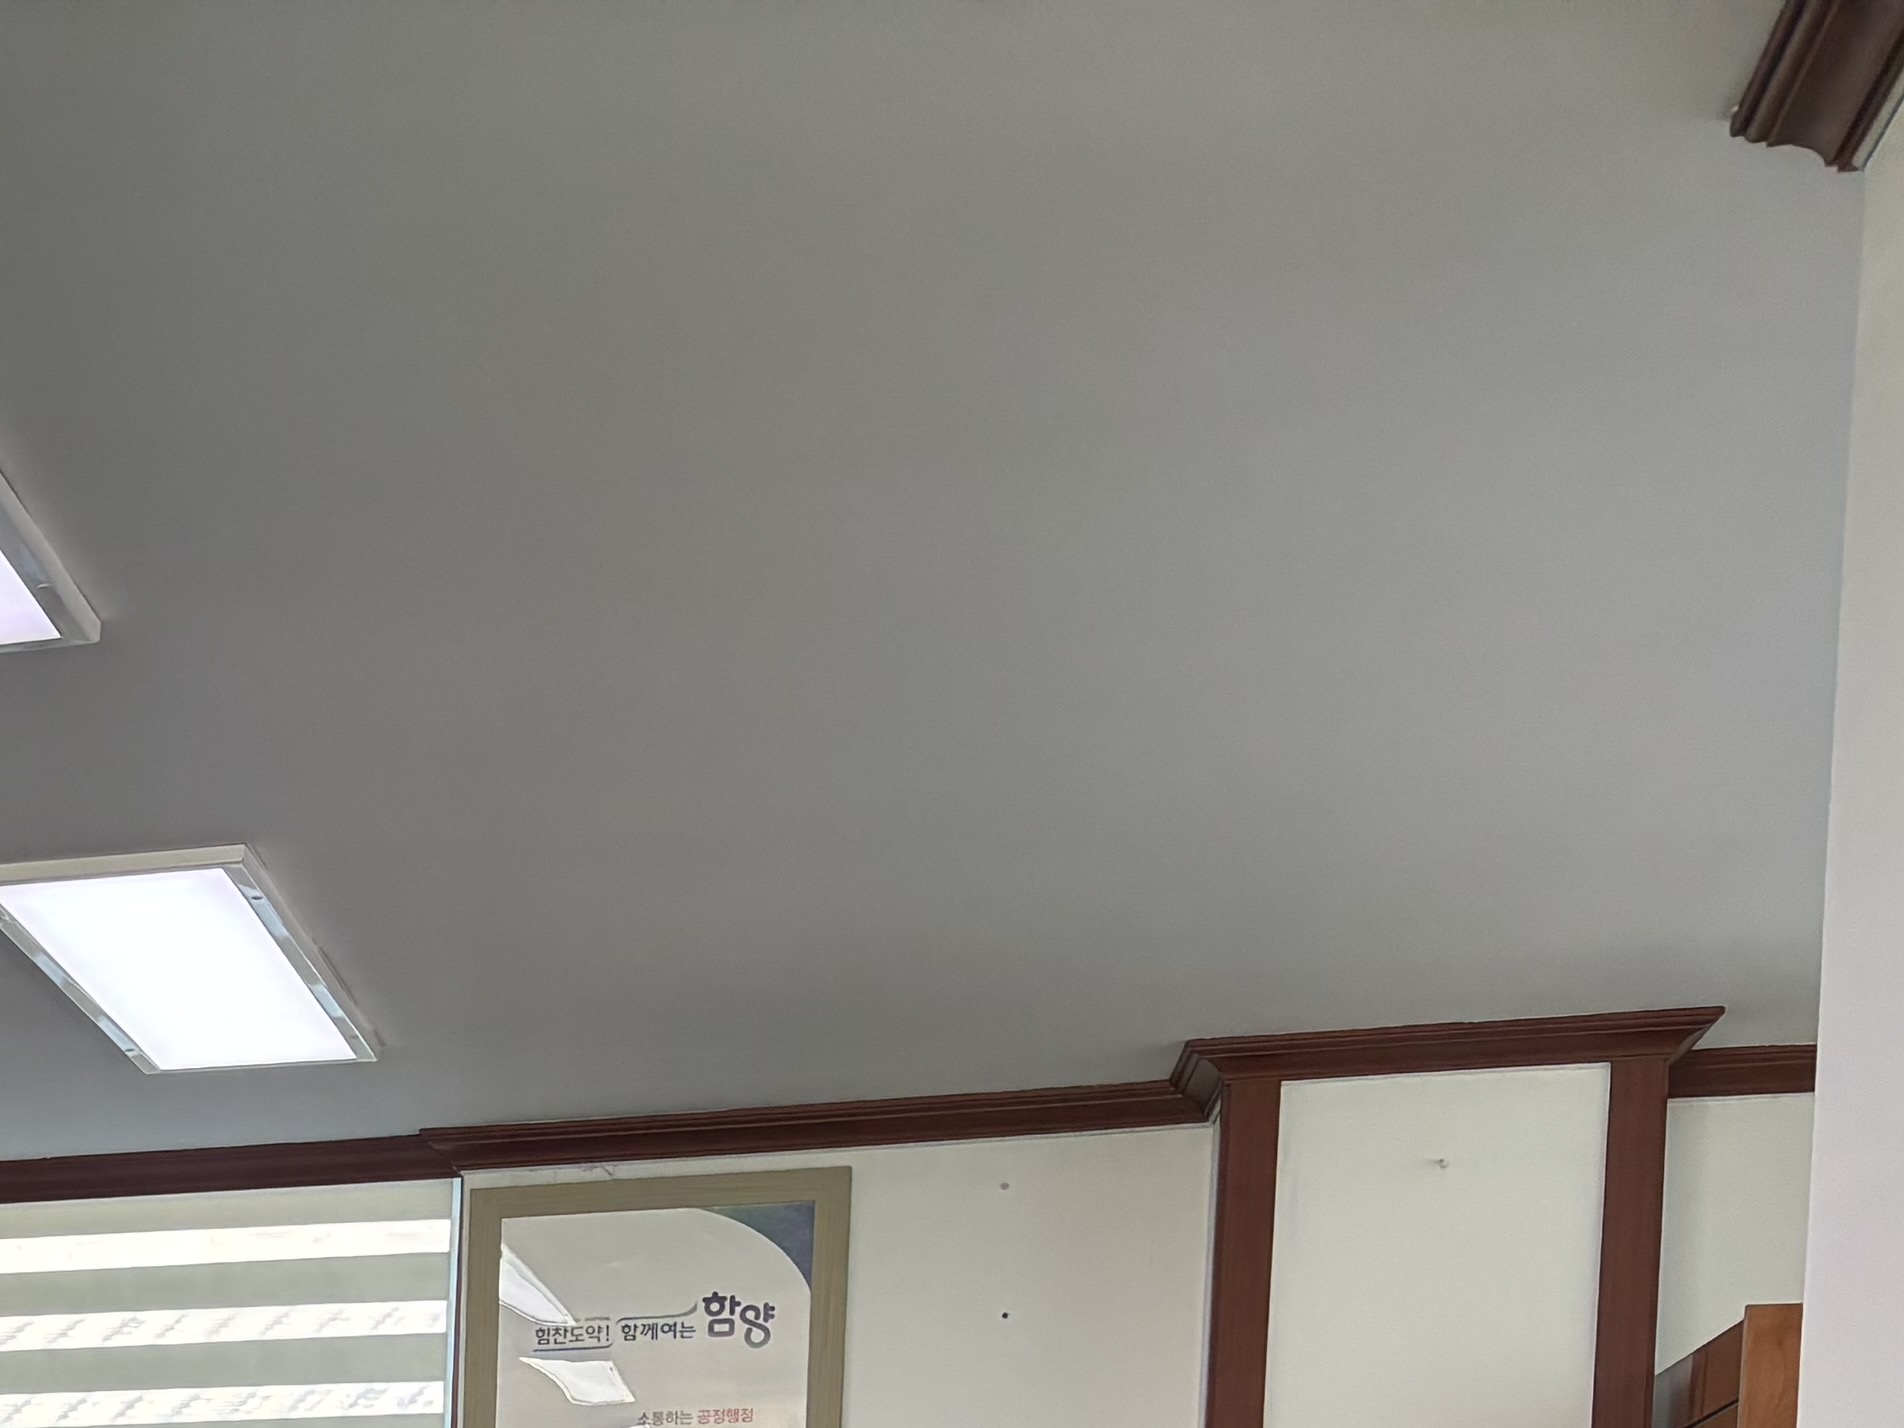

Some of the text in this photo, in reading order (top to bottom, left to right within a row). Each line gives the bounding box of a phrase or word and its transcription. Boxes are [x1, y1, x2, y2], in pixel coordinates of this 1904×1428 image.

[535, 1291, 776, 1349] 힘찬도약! 함께여는 함양
[637, 1408, 754, 1426] 소통하는 공정행정
